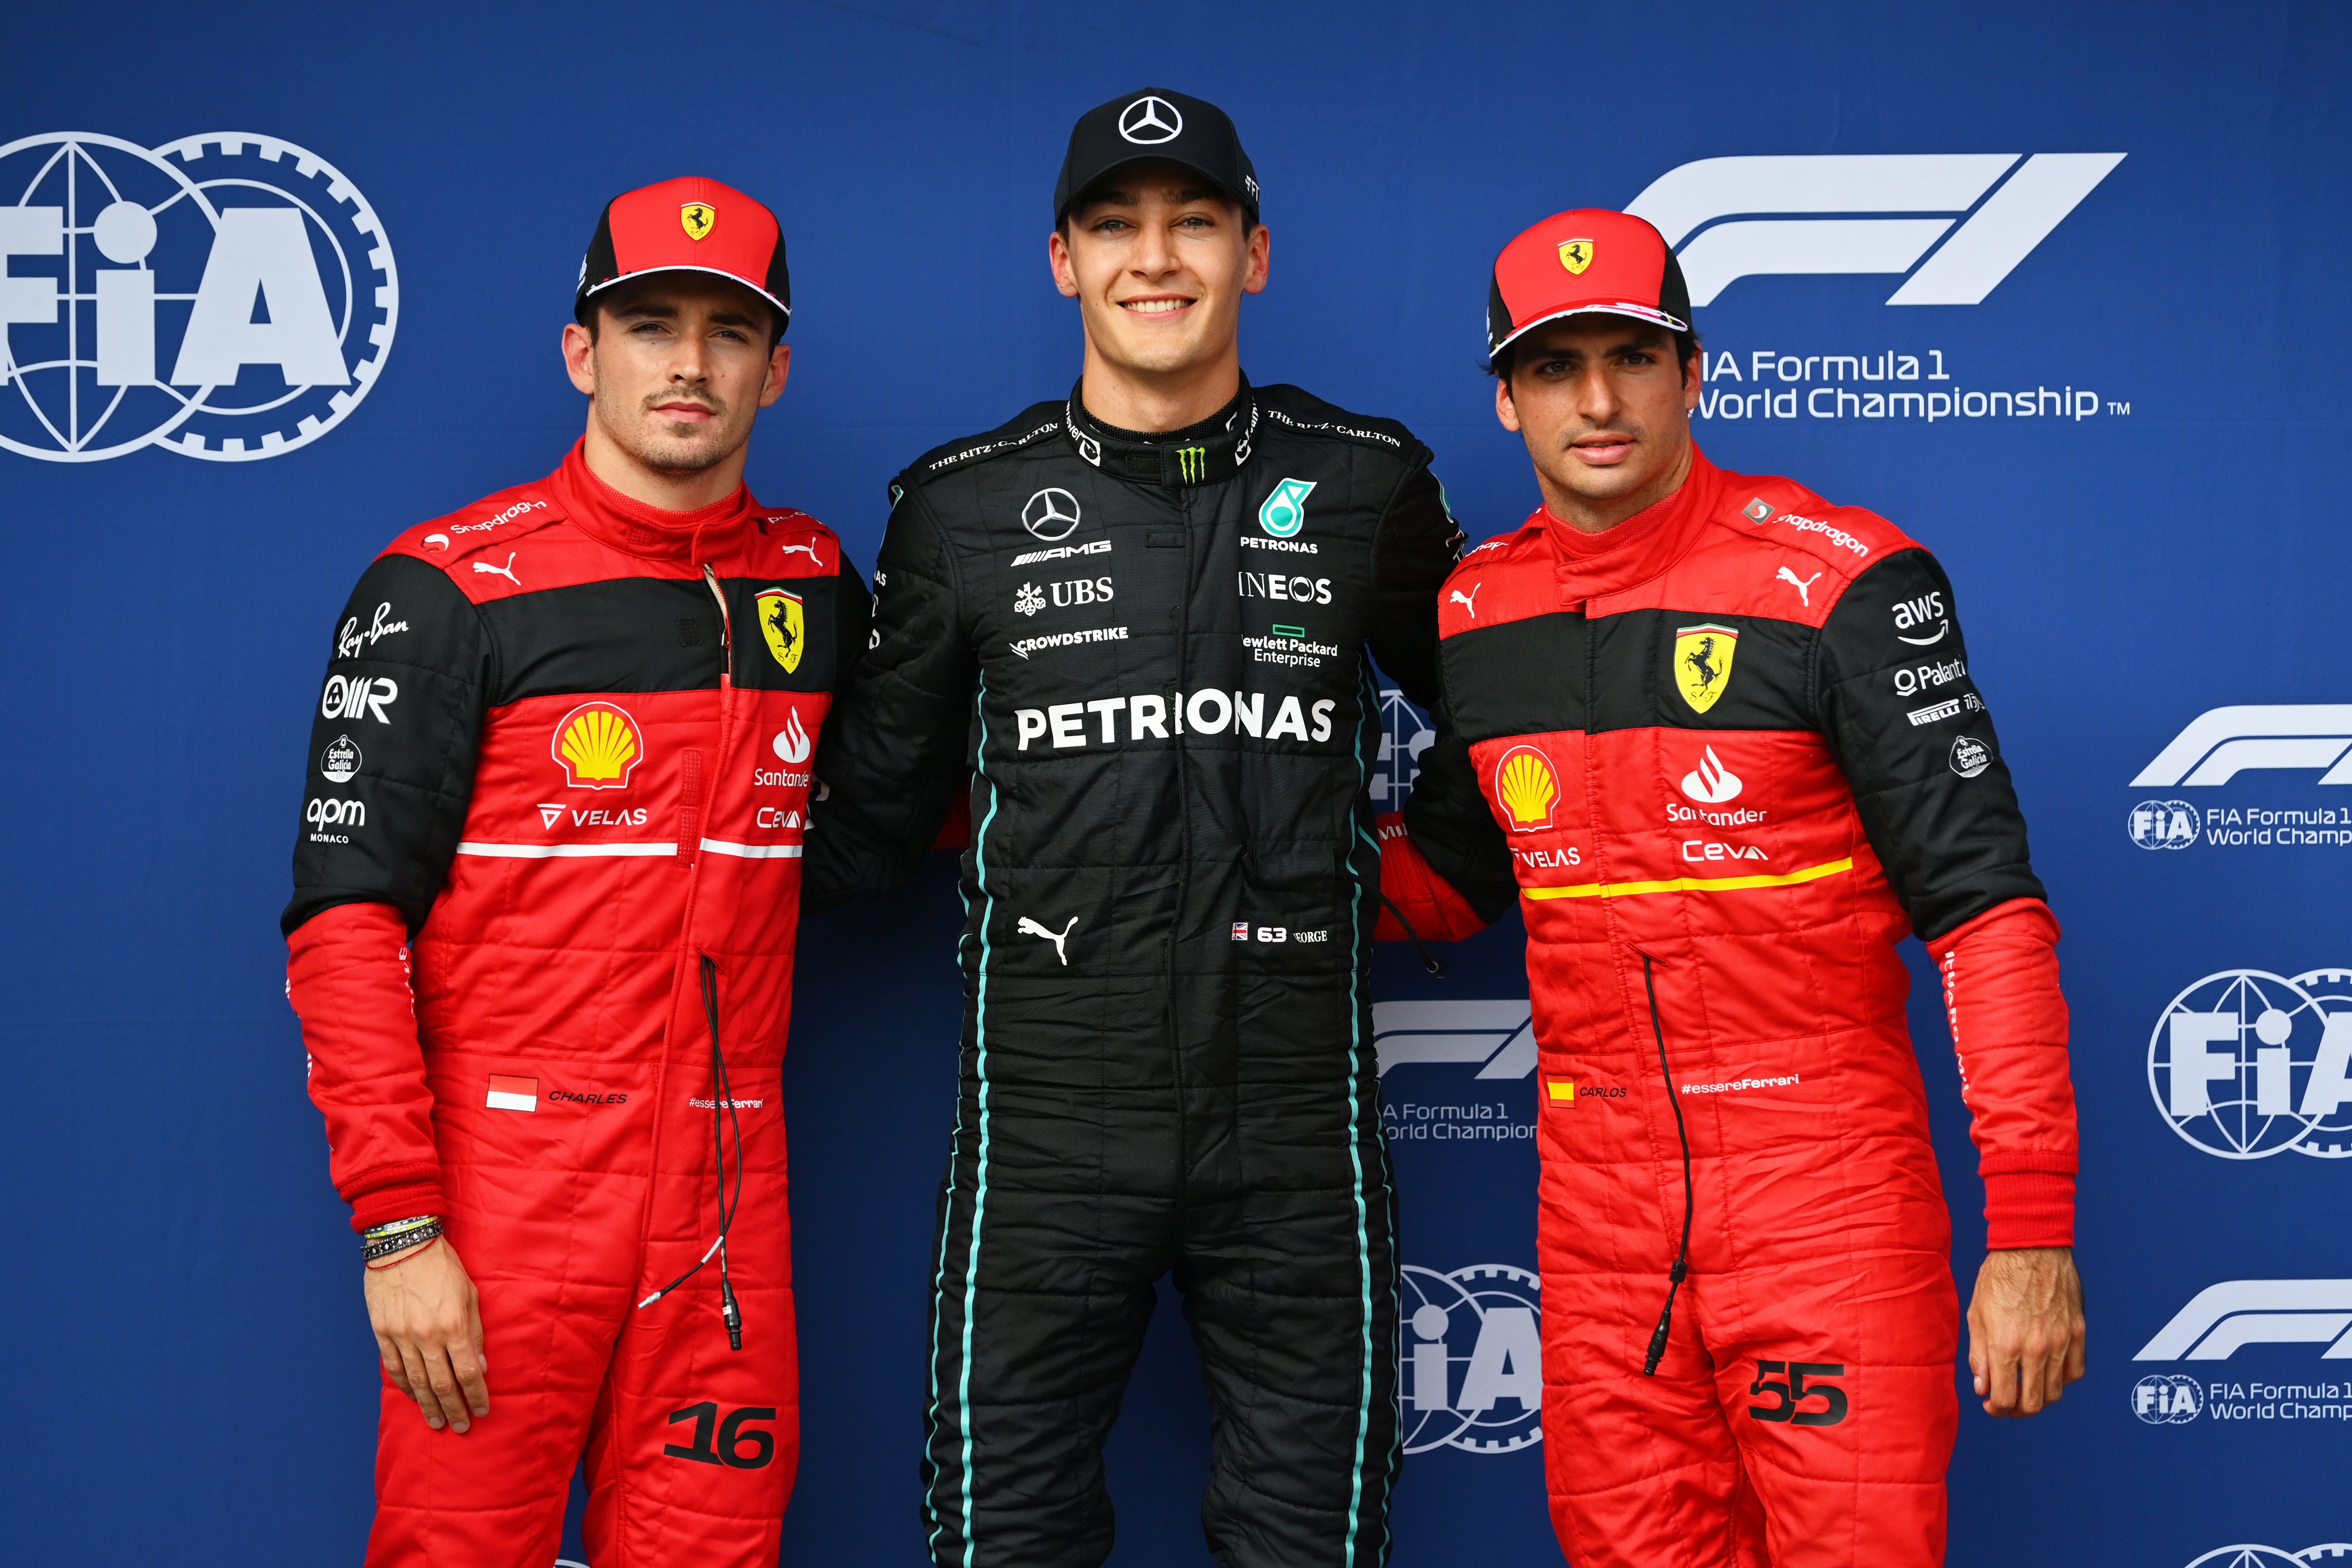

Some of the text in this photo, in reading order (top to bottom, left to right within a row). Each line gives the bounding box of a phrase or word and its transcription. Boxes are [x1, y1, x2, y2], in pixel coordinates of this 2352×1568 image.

[1251, 179, 1260, 202] FT
[1702, 350, 1950, 382] IA Formula 1
[1807, 386, 2098, 423] Championship
[1268, 410, 1294, 426] THE
[930, 455, 957, 470] THE
[1041, 539, 1112, 561] AMG
[1240, 536, 1318, 554] PETRONAS
[1050, 577, 1114, 607] UBS
[1238, 571, 1332, 604] INEOS
[1892, 591, 1944, 629] aws
[1017, 627, 1128, 651] CROWDSTRIKE
[1241, 634, 1338, 656] ewlett Packard
[778, 652, 785, 662] S
[1254, 648, 1321, 667] Enterprise
[1689, 691, 1697, 702] S
[1014, 688, 1336, 751] PETRONAS
[1907, 698, 1961, 726] PIRELLI
[328, 749, 354, 759] Estrella
[1957, 745, 1984, 759] Estrella
[1960, 753, 1987, 769] Galicia
[328, 759, 351, 770] Galicia
[754, 768, 810, 787] Santander
[306, 798, 365, 832] apm
[571, 808, 647, 826] VELAS
[1666, 804, 1767, 826] Santander
[2207, 808, 2242, 825] FIA
[2247, 808, 2336, 825] Formula
[2340, 808, 2352, 824] 1
[310, 834, 349, 844] MONACO
[2206, 828, 2352, 847] World Champ
[1521, 847, 1581, 868] VELAS
[1257, 927, 1287, 942] 63
[1580, 1087, 1626, 1097] CARLOS
[1681, 1074, 1799, 1094] #essereFerrari
[549, 1091, 628, 1104] CHARLES
[1403, 1104, 1492, 1120] Formula
[1496, 1103, 1509, 1119] 1
[1386, 1124, 1427, 1140] orld
[1748, 1360, 1848, 1426] 55
[2210, 1383, 2245, 1399] FIA
[2250, 1382, 2339, 1399] Formula
[2209, 1403, 2274, 1420] World
[663, 1401, 776, 1470] 16
